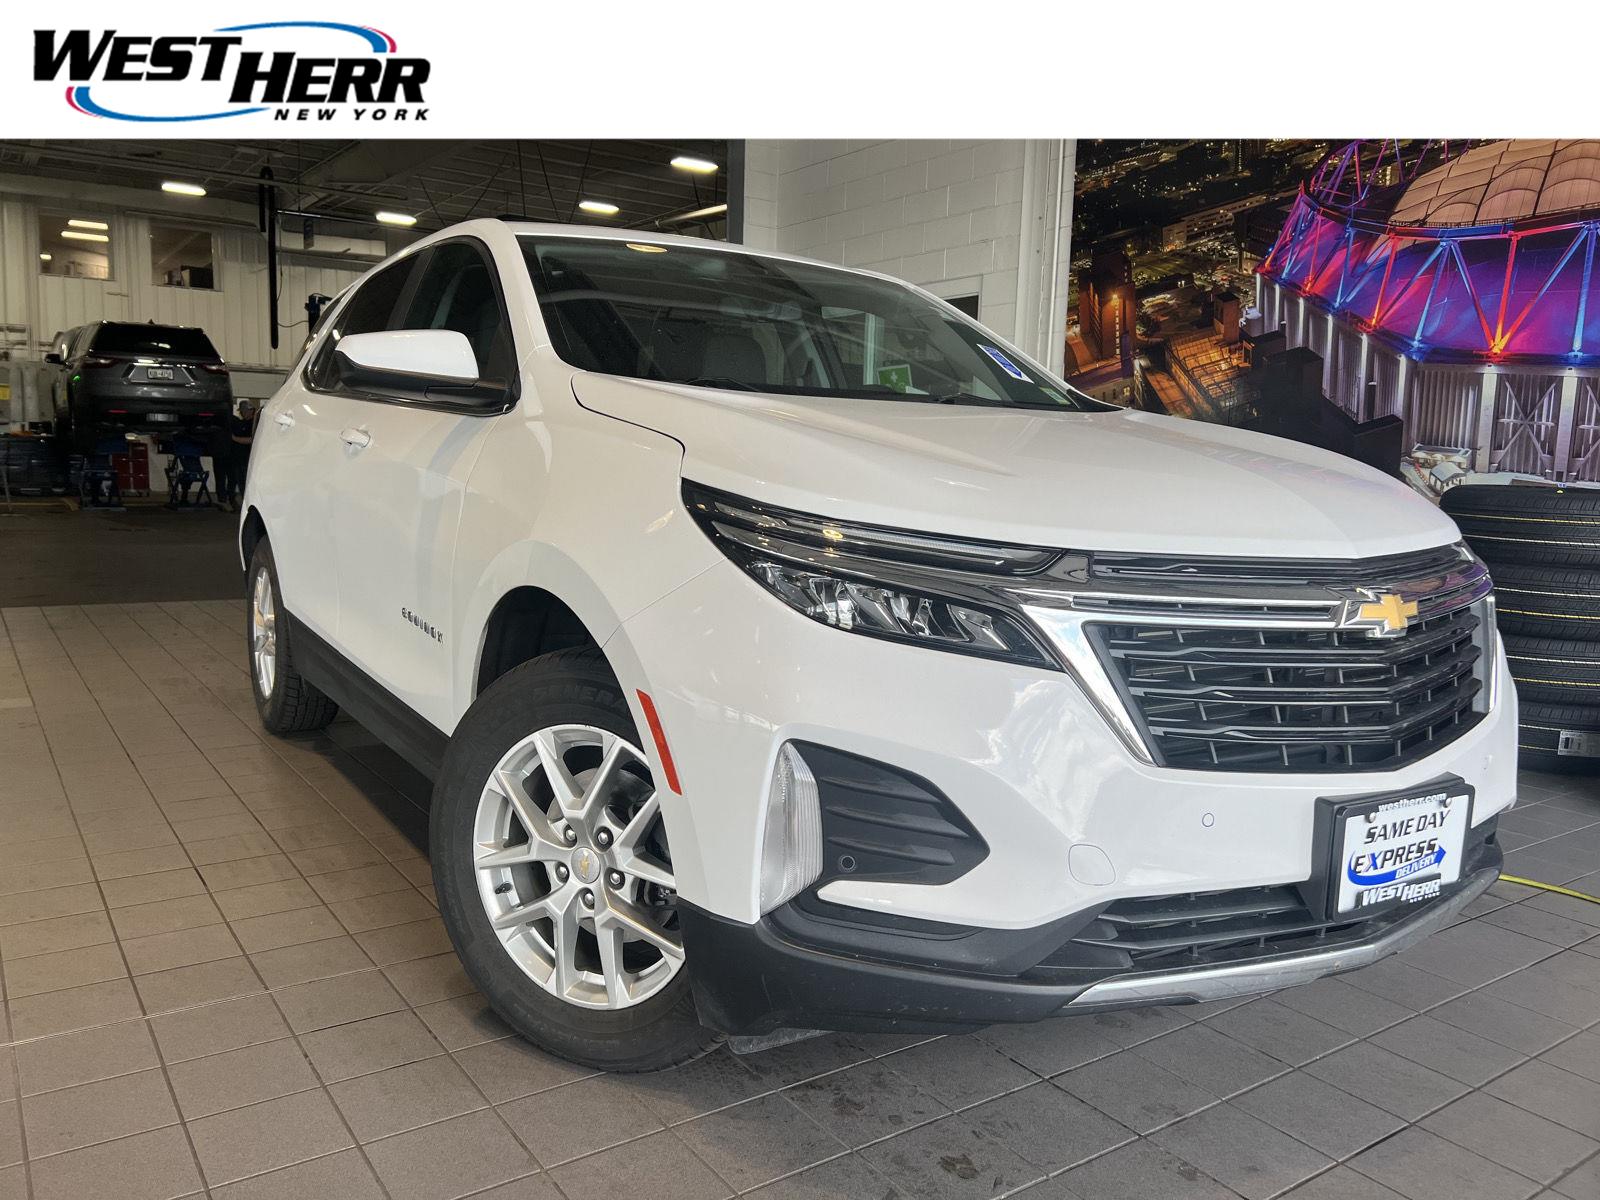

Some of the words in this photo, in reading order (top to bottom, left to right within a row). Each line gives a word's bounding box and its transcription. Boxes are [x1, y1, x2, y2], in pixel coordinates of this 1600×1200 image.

[532, 684, 627, 709] GENERA
[1364, 818, 1415, 844] SAME
[1416, 809, 1451, 833] DAY
[1353, 838, 1438, 874] EXPRESS
[1396, 853, 1437, 879] DELIVERY
